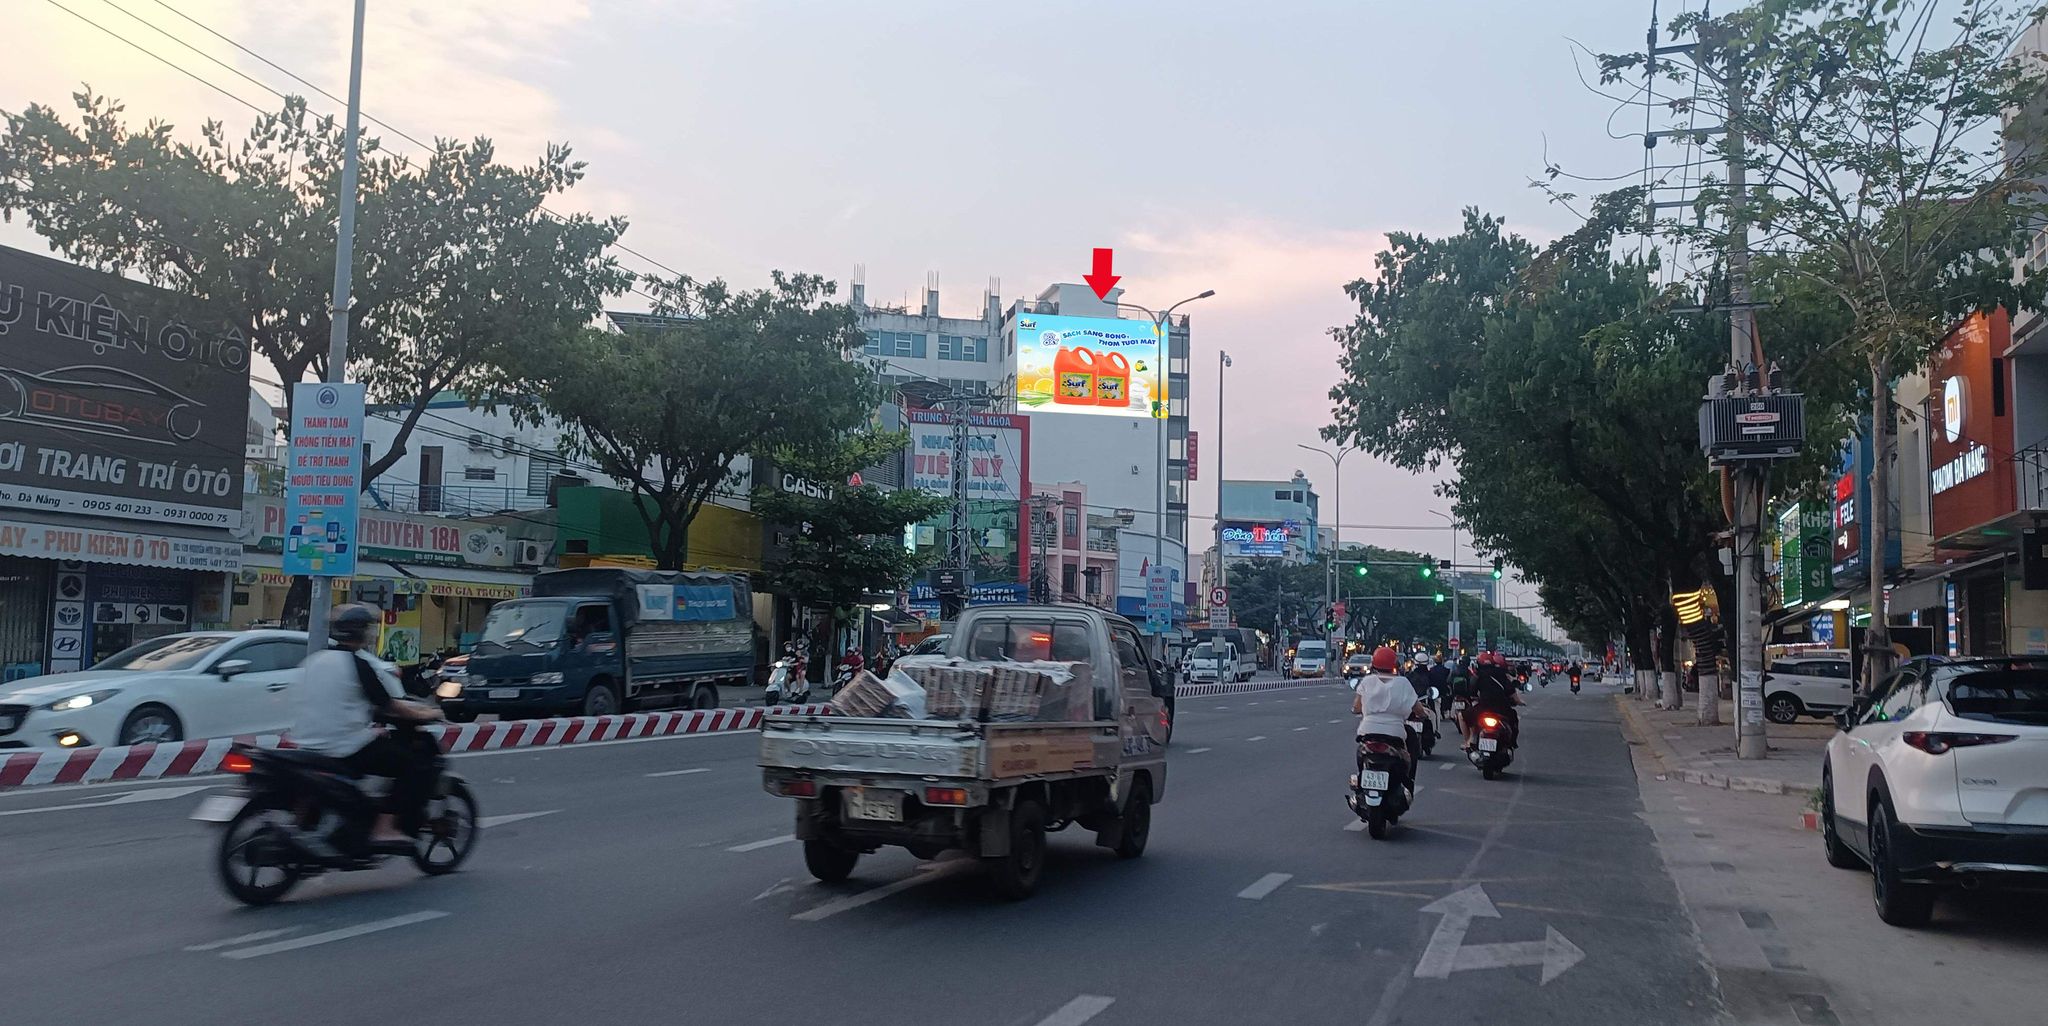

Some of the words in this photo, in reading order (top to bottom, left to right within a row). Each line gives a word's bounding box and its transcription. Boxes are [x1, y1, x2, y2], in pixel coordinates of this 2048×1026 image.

[36, 293, 148, 355] KIỆN
[1020, 320, 1036, 328] Surf
[1067, 378, 1086, 388] Surf
[1101, 382, 1119, 390] Surf
[304, 417, 328, 429] THANH
[912, 411, 942, 423] TRUNG
[986, 417, 1011, 427] KHOA
[922, 434, 951, 449] NHA
[967, 436, 996, 452] HOA
[37, 447, 127, 484] TRANG
[138, 460, 178, 490] TRÍ
[182, 463, 231, 497] ÔTÔ
[914, 450, 950, 478] VIỆ
[1932, 460, 1954, 495] XIAOMI
[1954, 451, 1965, 485] ĐÀ
[18, 492, 32, 502] Đà
[82, 499, 111, 511] 0905
[114, 503, 132, 514] 401
[134, 505, 152, 515] 233
[163, 508, 187, 519] 0931
[189, 511, 214, 522] 0000
[216, 513, 228, 523] 75
[324, 495, 344, 506] MINH
[44, 529, 82, 557] PHỤ
[87, 531, 129, 560] KIỆN
[133, 535, 145, 559] Ô
[149, 537, 170, 561] TÔ
[429, 526, 460, 552] 18A
[455, 586, 473, 596] GIA
[520, 587, 532, 596] 18
[971, 587, 1018, 602] DENTAL
